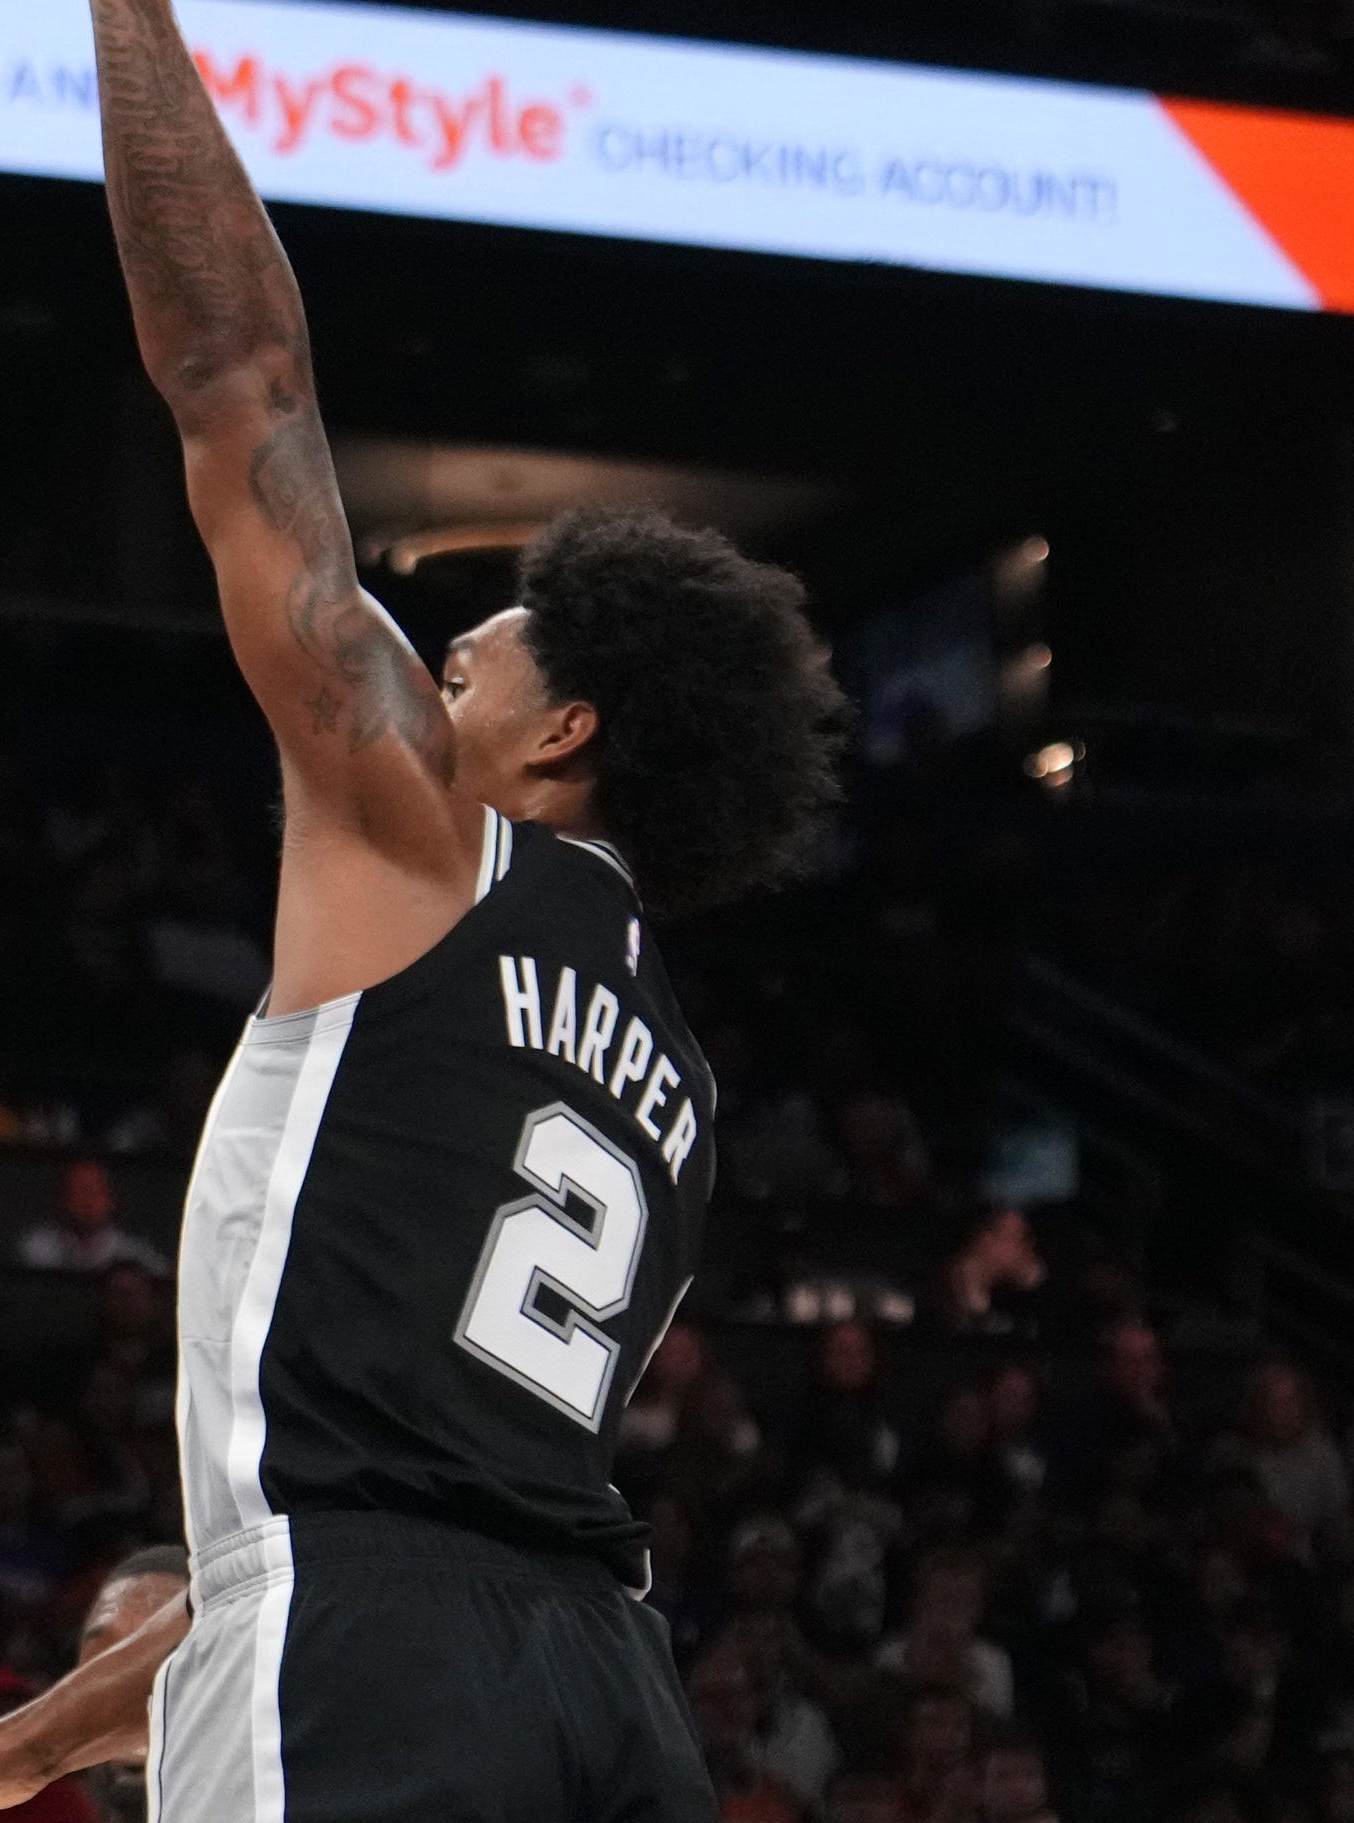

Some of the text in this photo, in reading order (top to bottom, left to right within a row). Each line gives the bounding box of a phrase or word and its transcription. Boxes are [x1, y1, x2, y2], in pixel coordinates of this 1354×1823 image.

[191, 52, 564, 174] MyStyle
[592, 122, 1120, 224] CHECKING ACCOUNT!
[498, 955, 698, 1186] HARPER
[452, 1101, 649, 1435] 2
